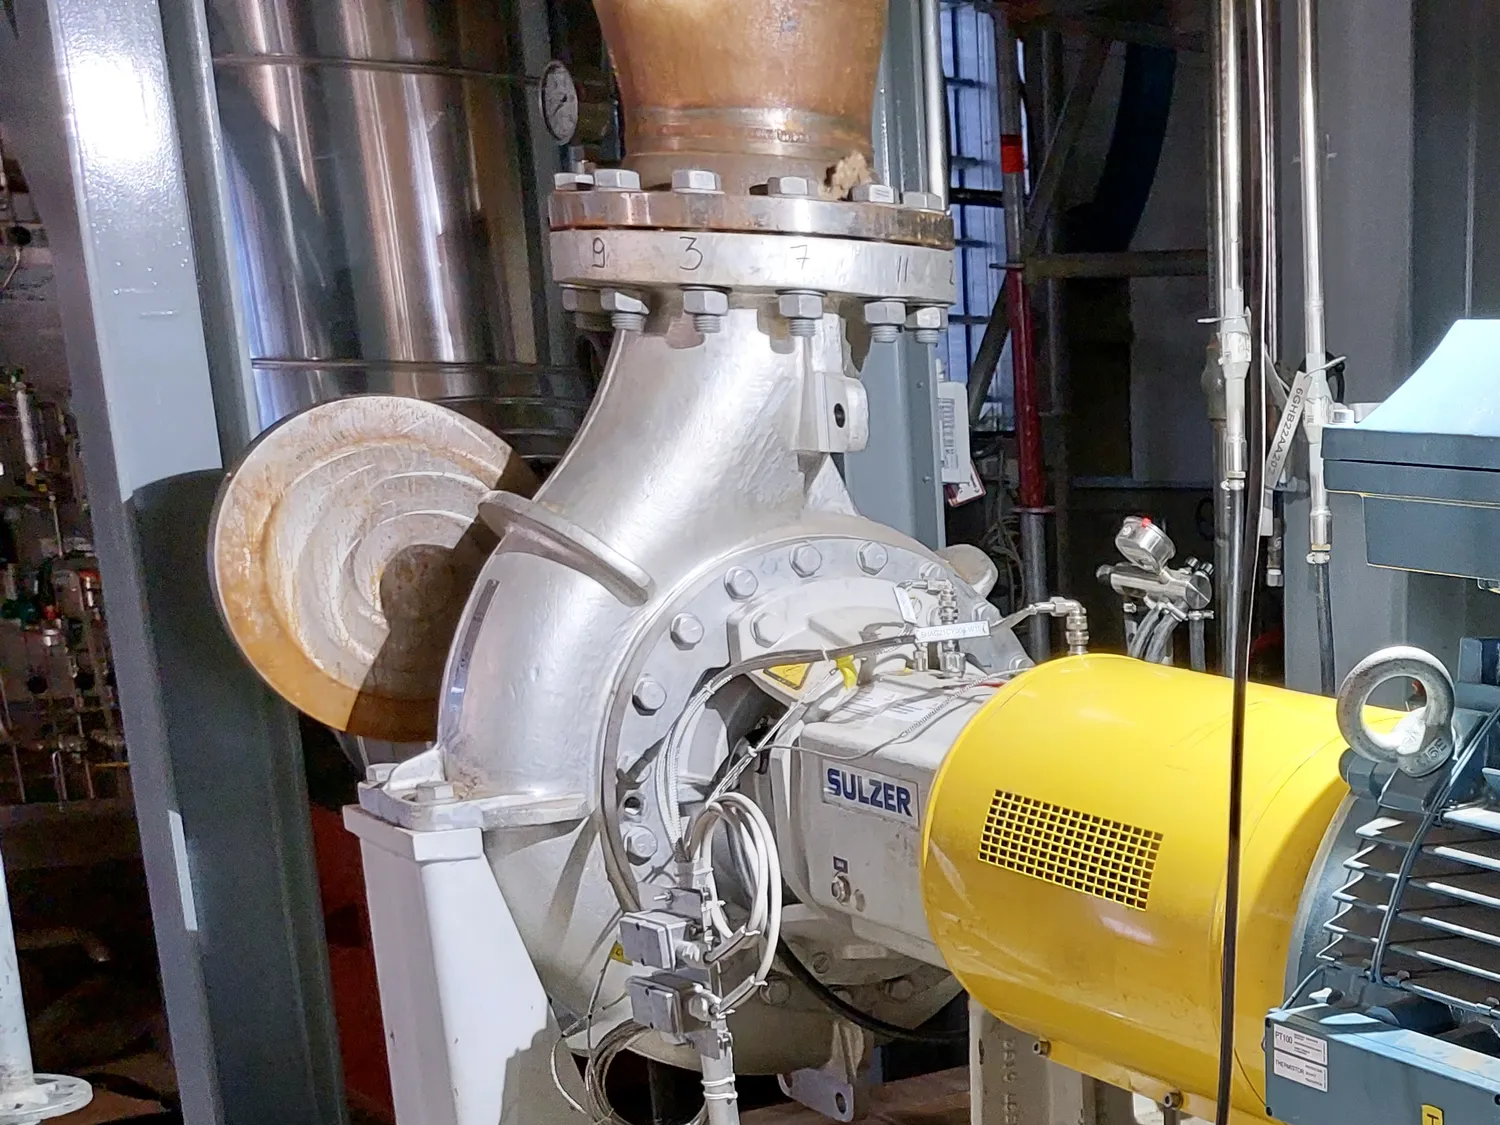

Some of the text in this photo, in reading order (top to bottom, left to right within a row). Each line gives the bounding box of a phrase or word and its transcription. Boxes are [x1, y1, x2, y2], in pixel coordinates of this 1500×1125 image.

[591, 236, 607, 269] 9
[679, 236, 705, 271] 3
[790, 245, 811, 271] 7
[826, 767, 914, 818] SULZER
[1275, 1030, 1293, 1045] PT100
